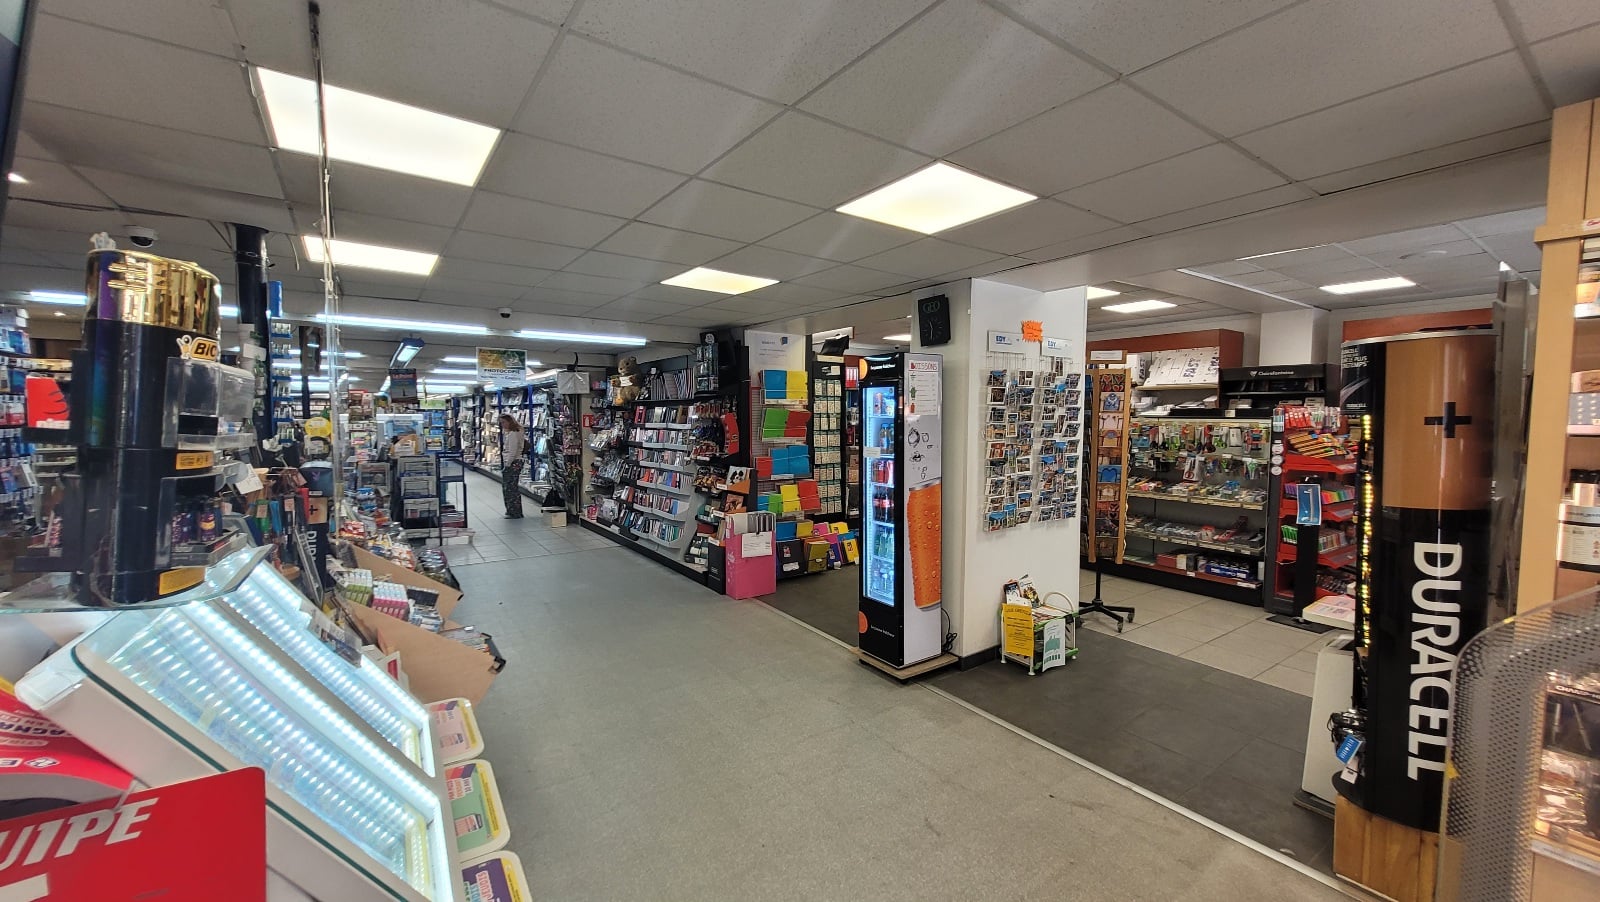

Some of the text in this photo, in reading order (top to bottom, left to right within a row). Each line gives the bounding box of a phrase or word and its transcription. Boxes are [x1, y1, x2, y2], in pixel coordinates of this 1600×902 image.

[923, 301, 940, 313] GEO
[194, 343, 217, 357] BIC
[911, 362, 937, 371] BOISSONS
[1184, 358, 1199, 378] FAST
[1407, 542, 1463, 780] DURACELL
